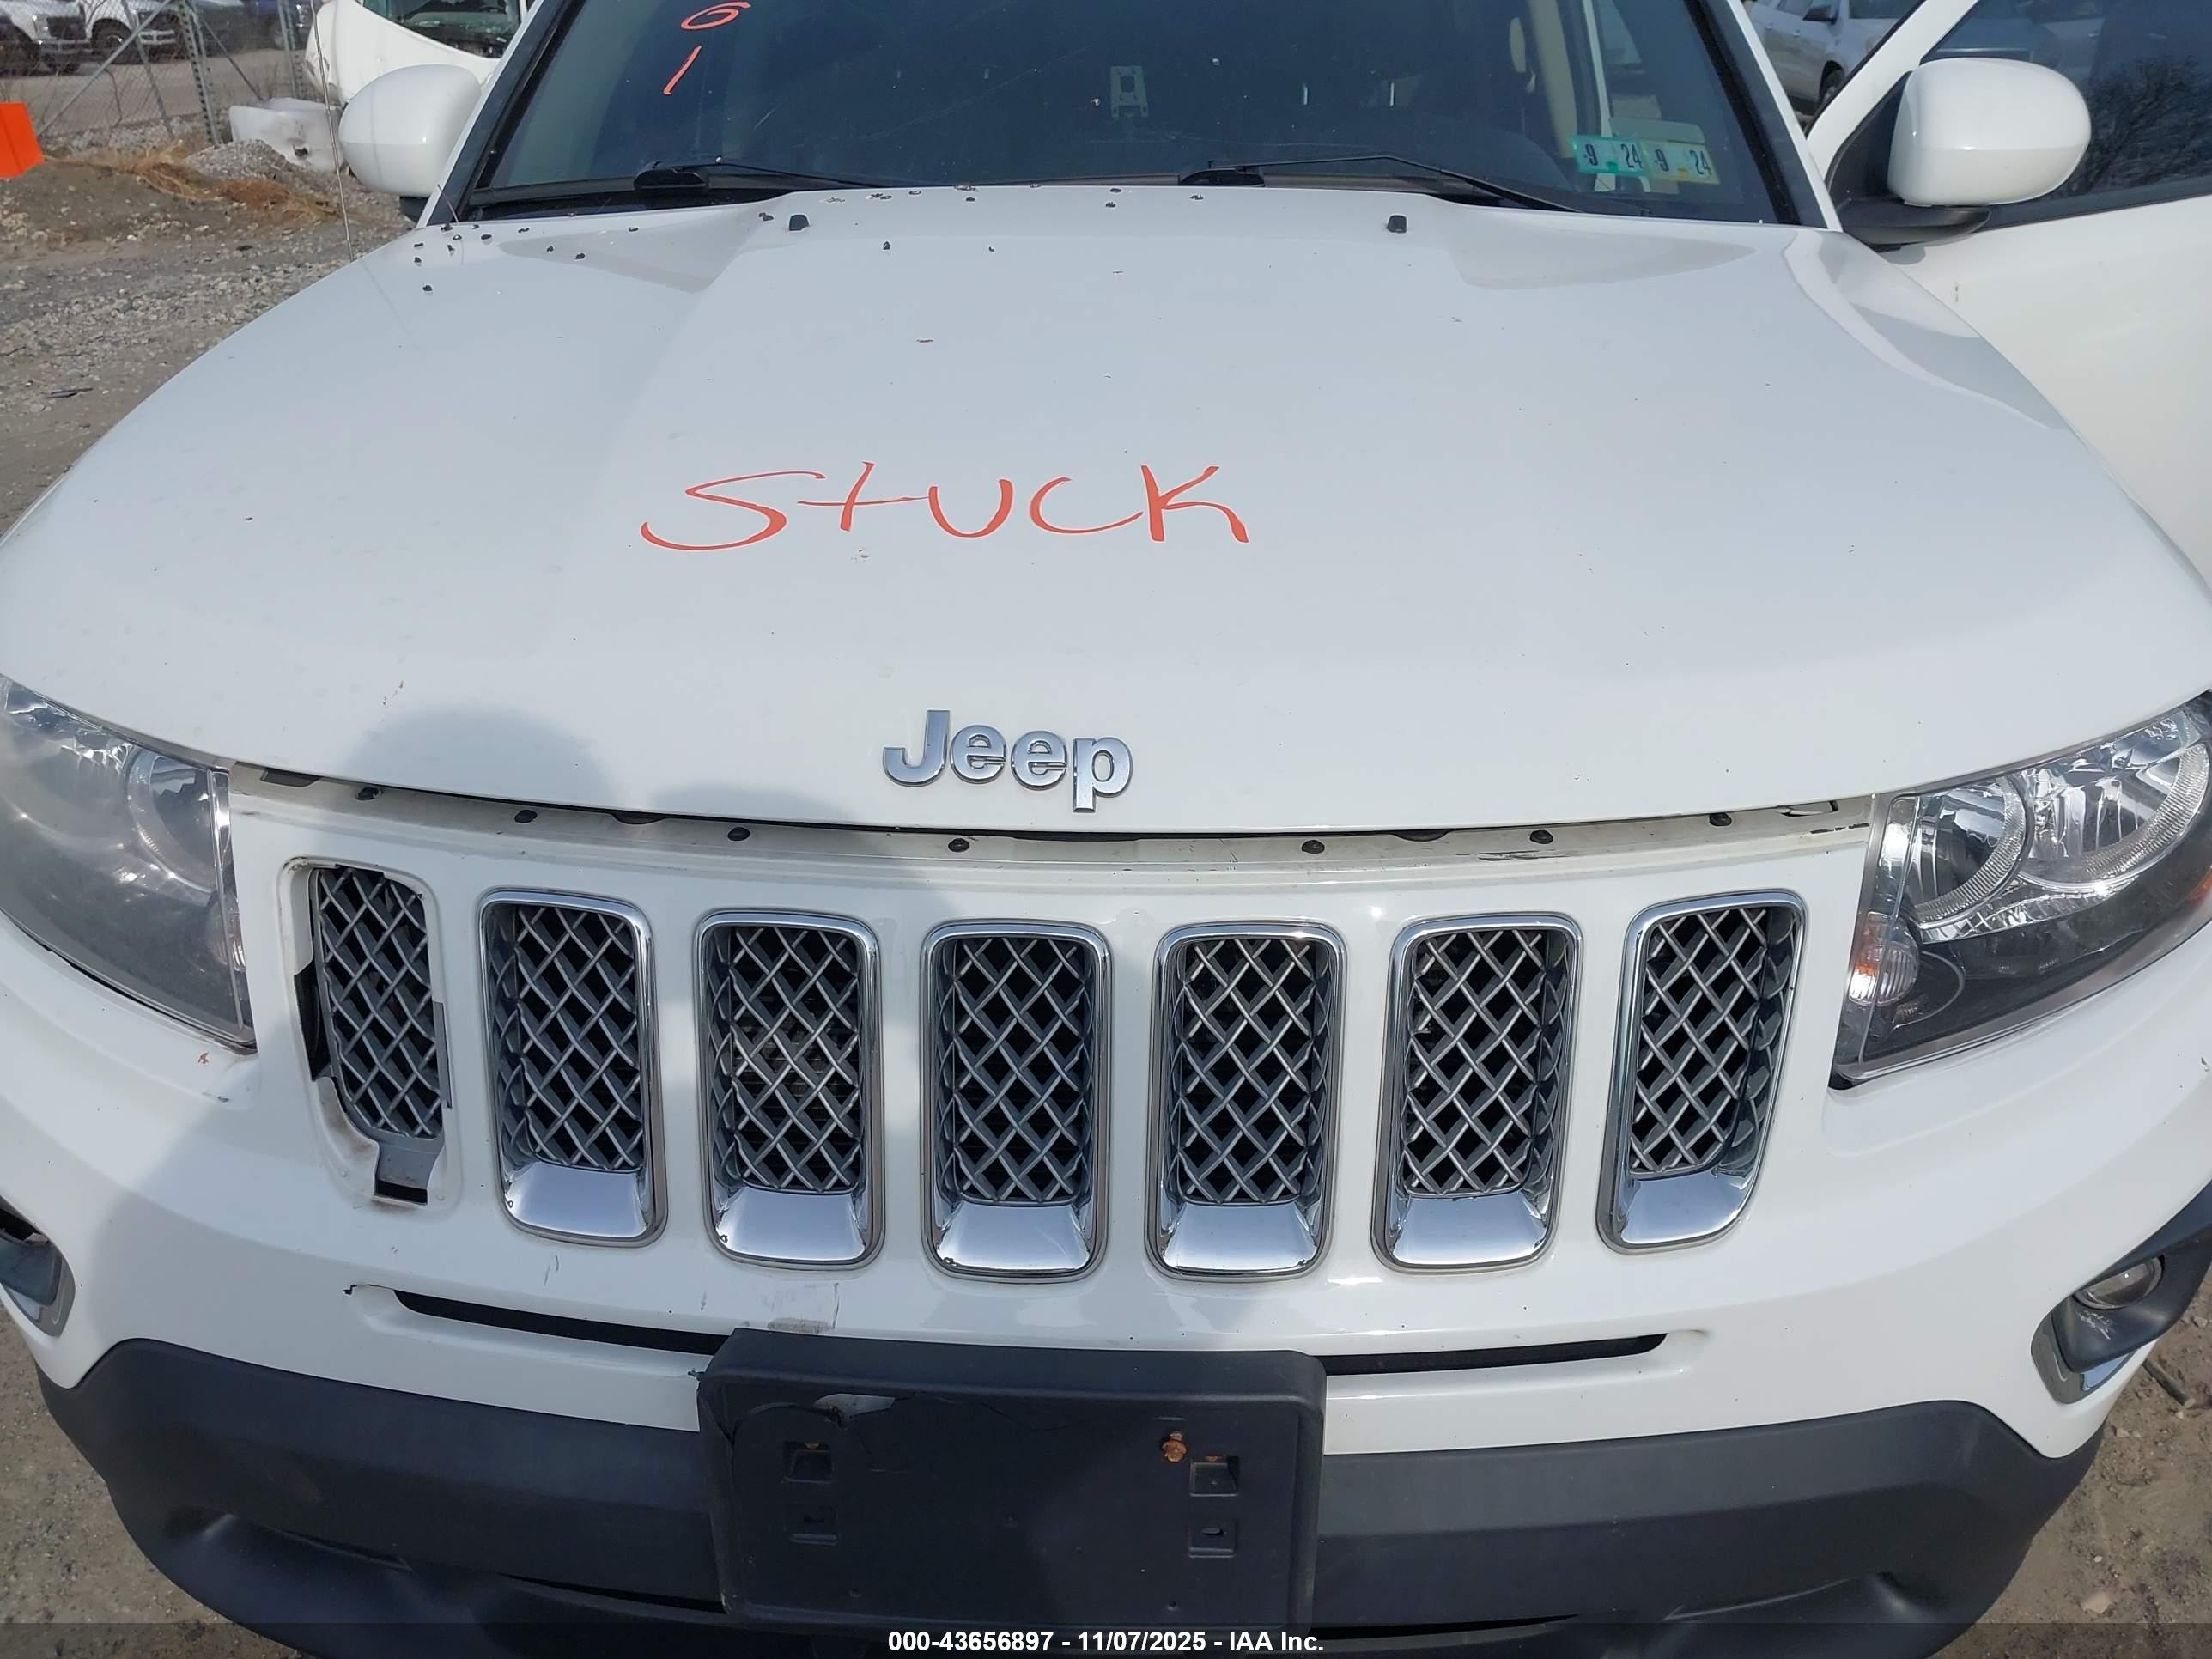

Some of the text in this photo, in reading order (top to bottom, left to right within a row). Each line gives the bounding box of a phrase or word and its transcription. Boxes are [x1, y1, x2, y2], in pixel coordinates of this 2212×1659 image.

[1620, 143, 1643, 168] 24
[1690, 149, 1712, 177] 24
[883, 709, 1133, 812] Jeep
